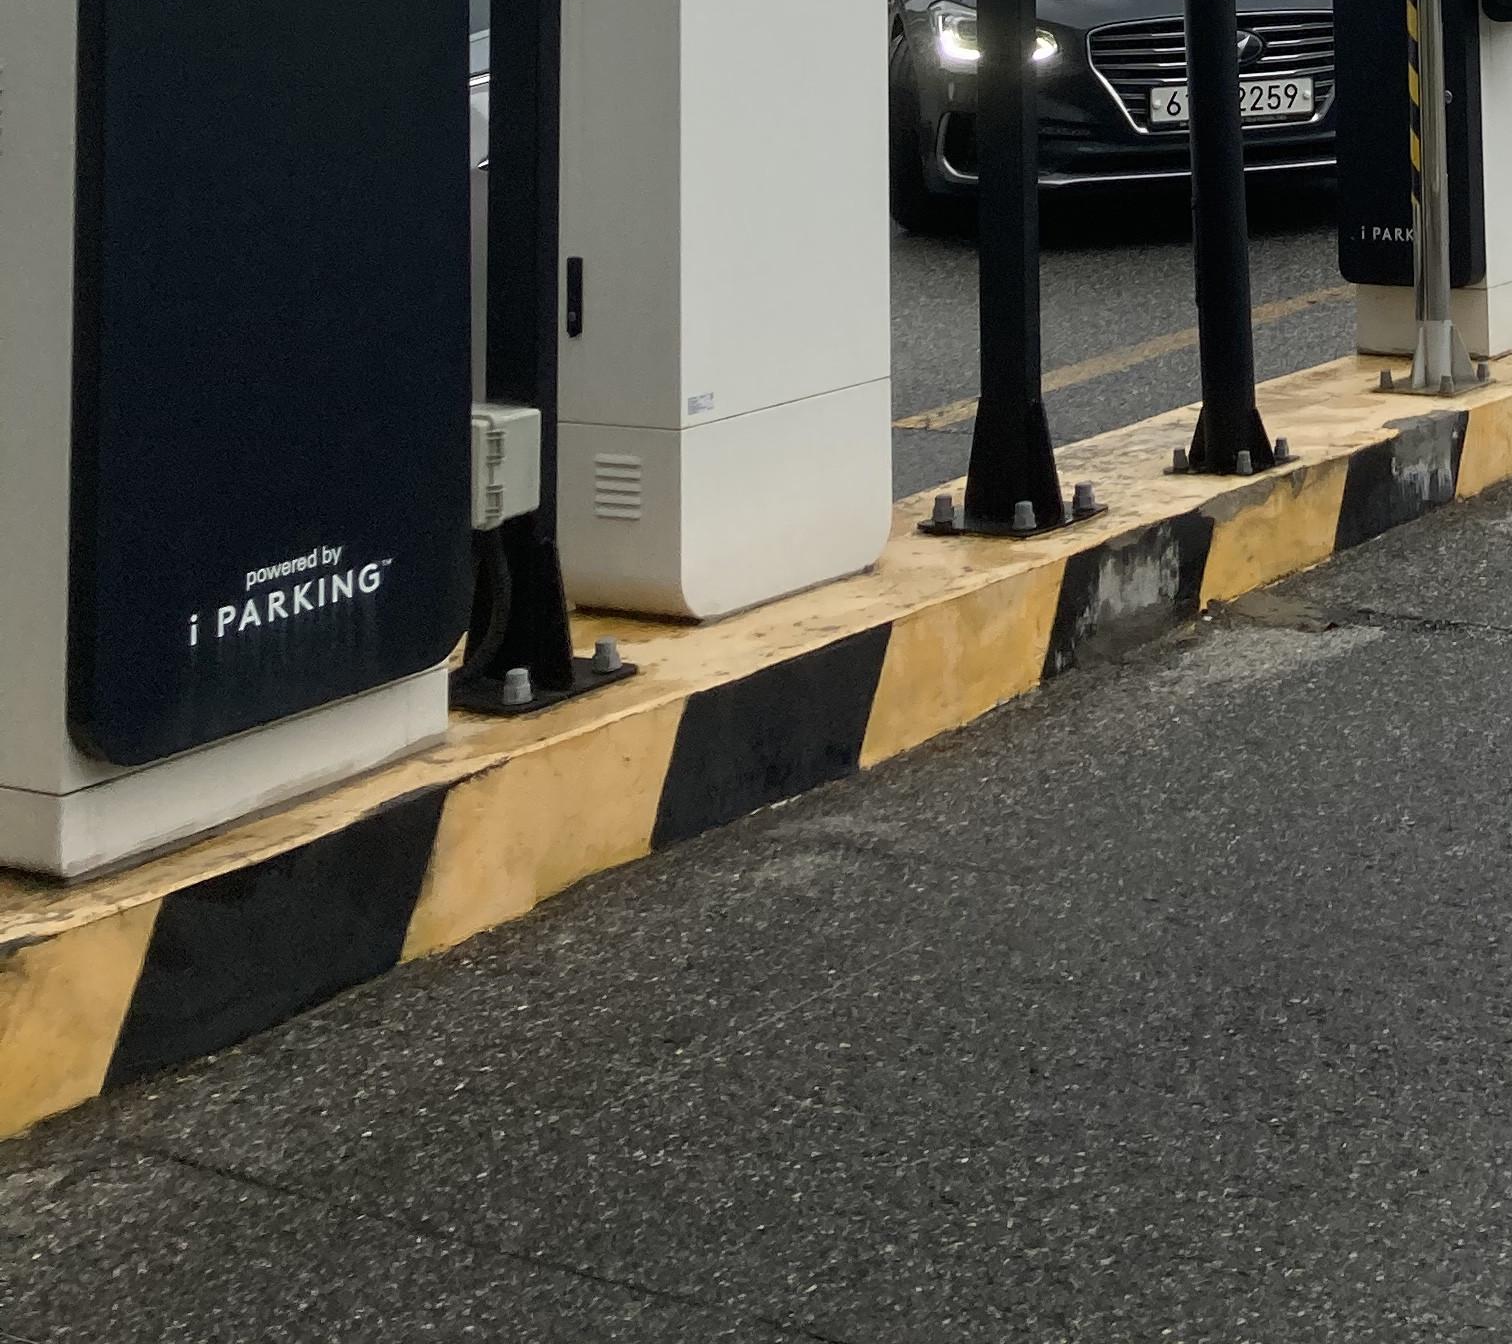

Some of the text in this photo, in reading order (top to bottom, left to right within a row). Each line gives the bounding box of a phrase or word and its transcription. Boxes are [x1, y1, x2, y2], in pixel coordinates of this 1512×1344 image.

[1372, 227, 1414, 242] PARK
[246, 545, 343, 591] powered by
[189, 614, 199, 646] i
